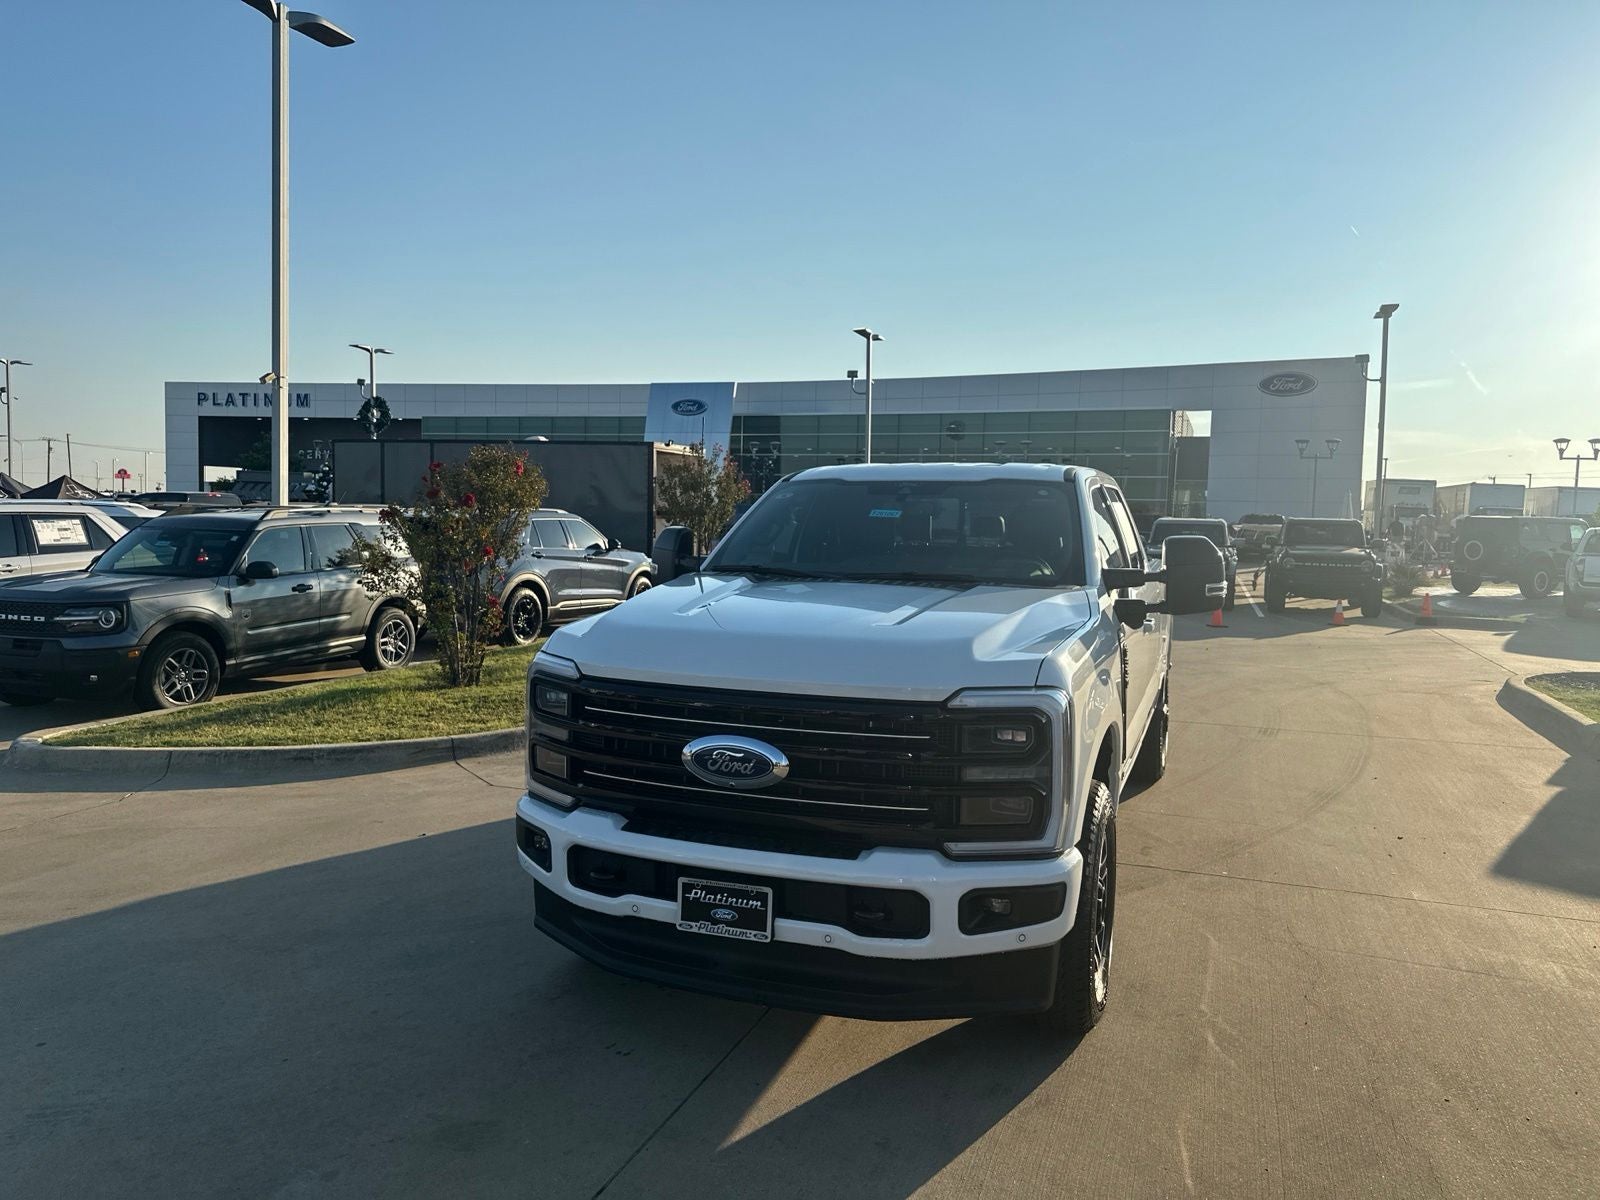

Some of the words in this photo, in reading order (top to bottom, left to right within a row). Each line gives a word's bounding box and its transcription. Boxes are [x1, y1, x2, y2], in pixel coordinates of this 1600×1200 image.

[1270, 377, 1303, 390] Ford
[197, 392, 310, 408] PLATINM
[705, 749, 757, 775] Ford
[685, 889, 766, 911] Platinum
[698, 922, 752, 938] Platinum
